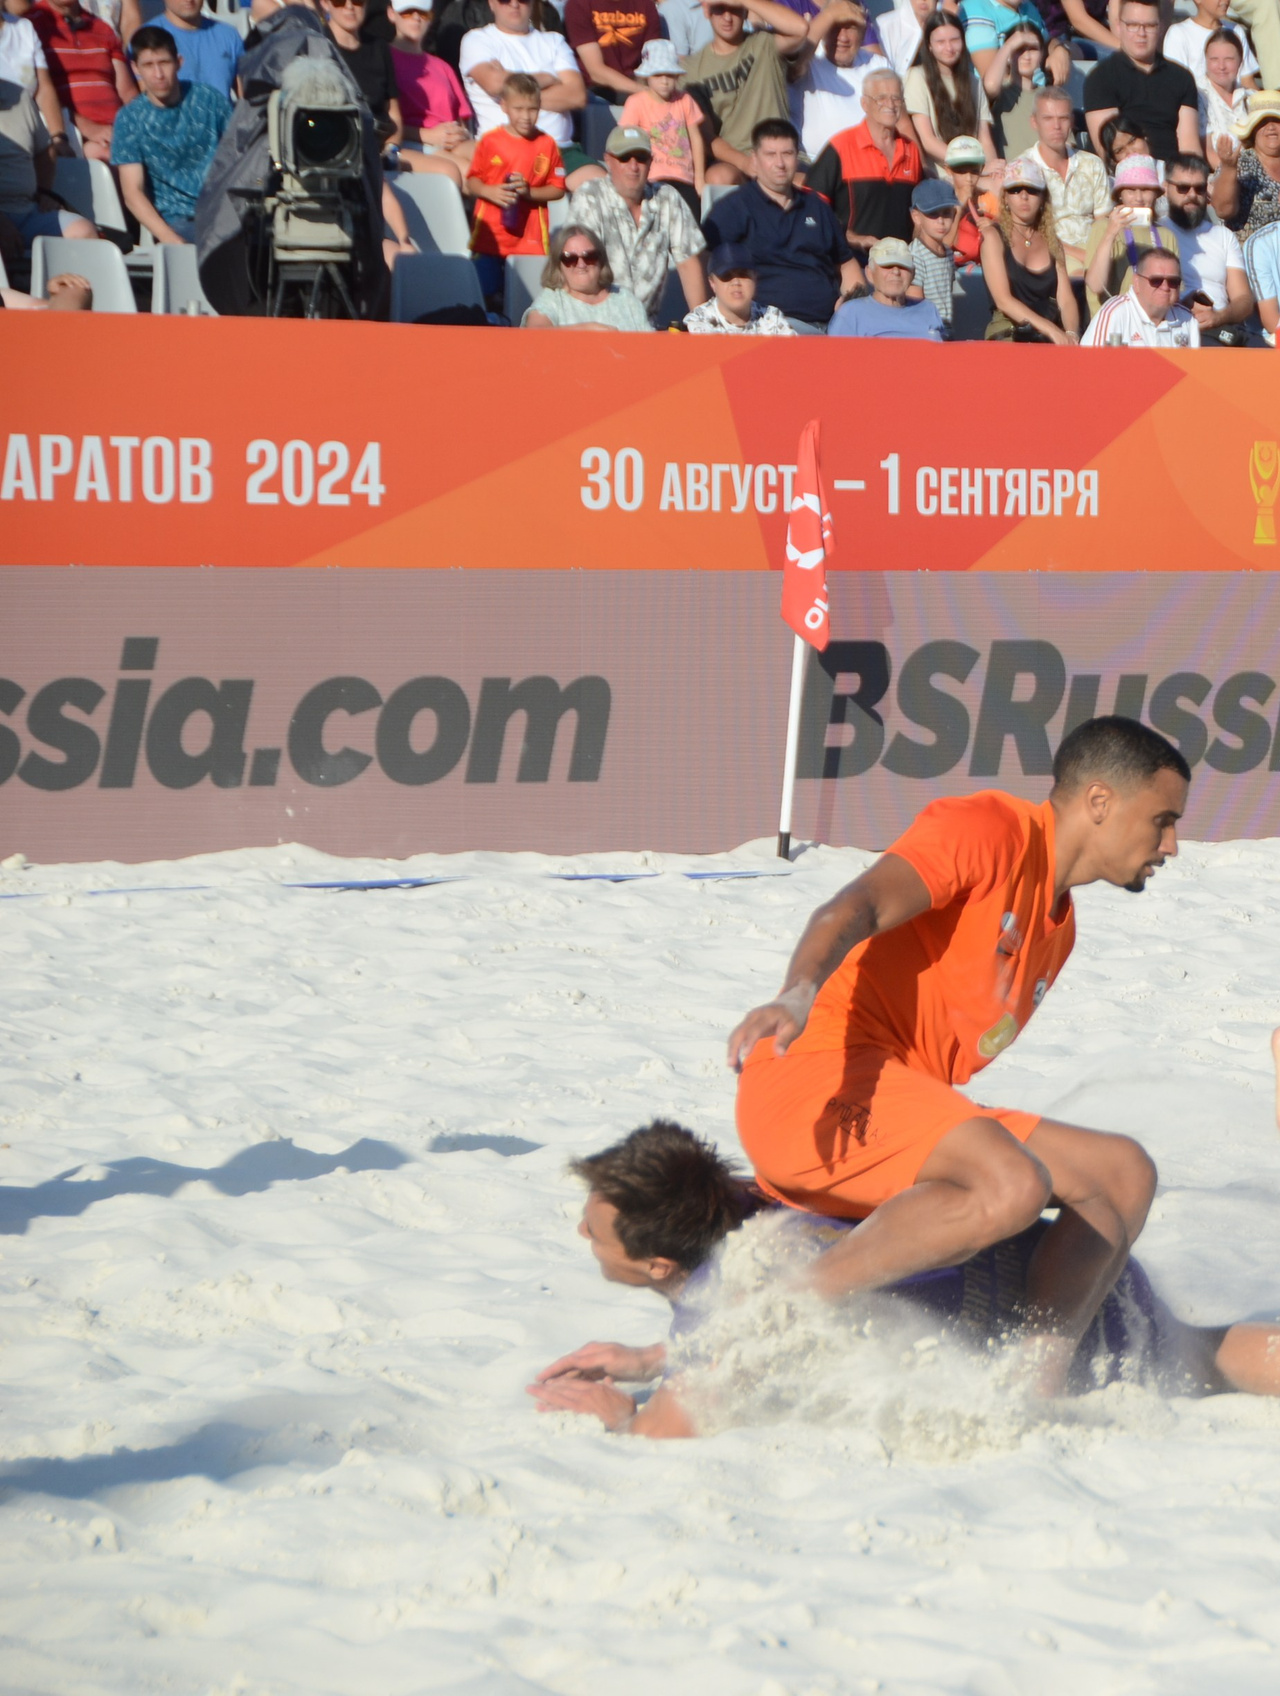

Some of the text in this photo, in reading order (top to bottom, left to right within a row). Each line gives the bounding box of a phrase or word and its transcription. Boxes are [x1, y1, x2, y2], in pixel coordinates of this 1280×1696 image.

[246, 439, 386, 507] 2024
[580, 446, 644, 512] 30
[659, 461, 799, 514] АВГУСТ
[880, 452, 901, 515] 1
[916, 465, 1099, 517] СЕНТЯБРЯ
